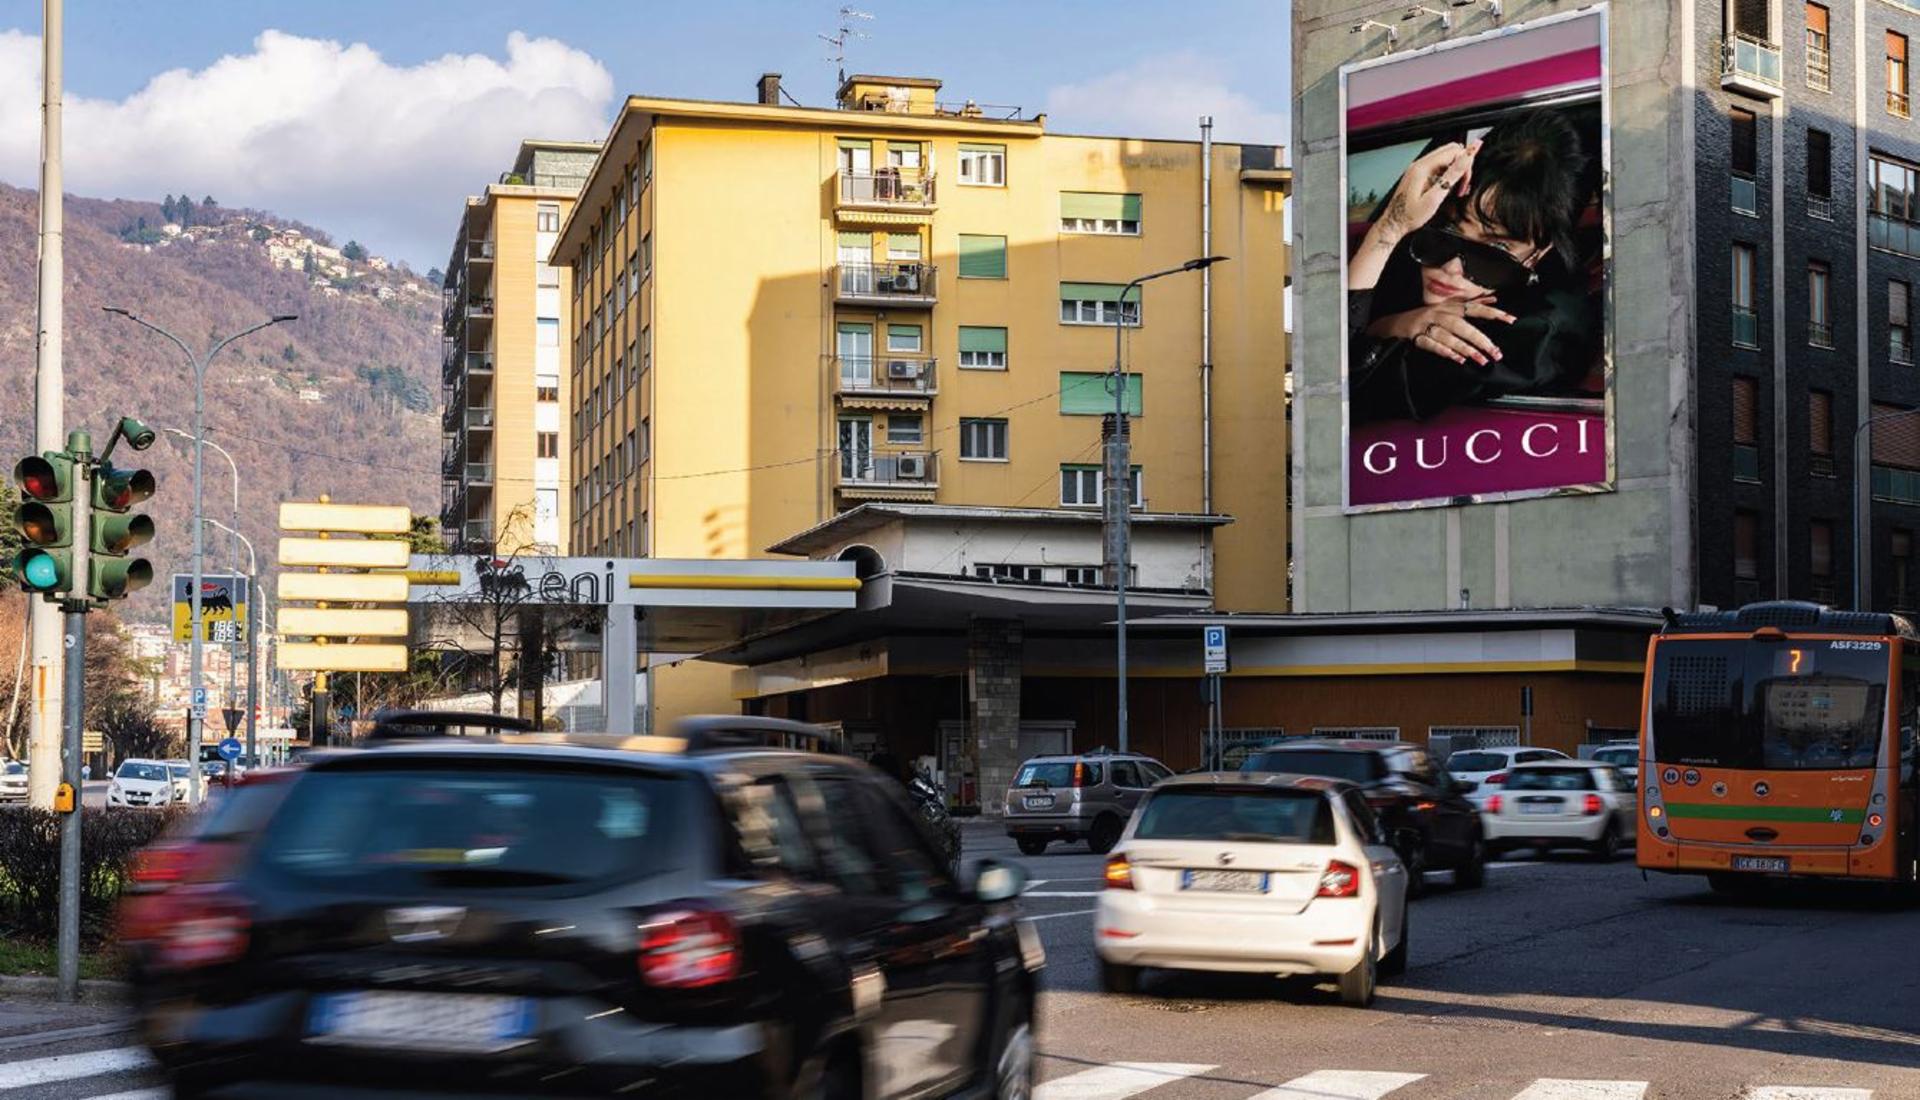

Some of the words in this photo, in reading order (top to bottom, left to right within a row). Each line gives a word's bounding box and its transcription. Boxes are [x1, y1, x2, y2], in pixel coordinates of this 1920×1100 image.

[1363, 420, 1588, 474] GUCCI
[540, 561, 614, 602] eni
[1210, 631, 1219, 644] P
[1830, 641, 1882, 650] ASF3229
[1790, 650, 1801, 672] 7
[195, 690, 203, 702] P
